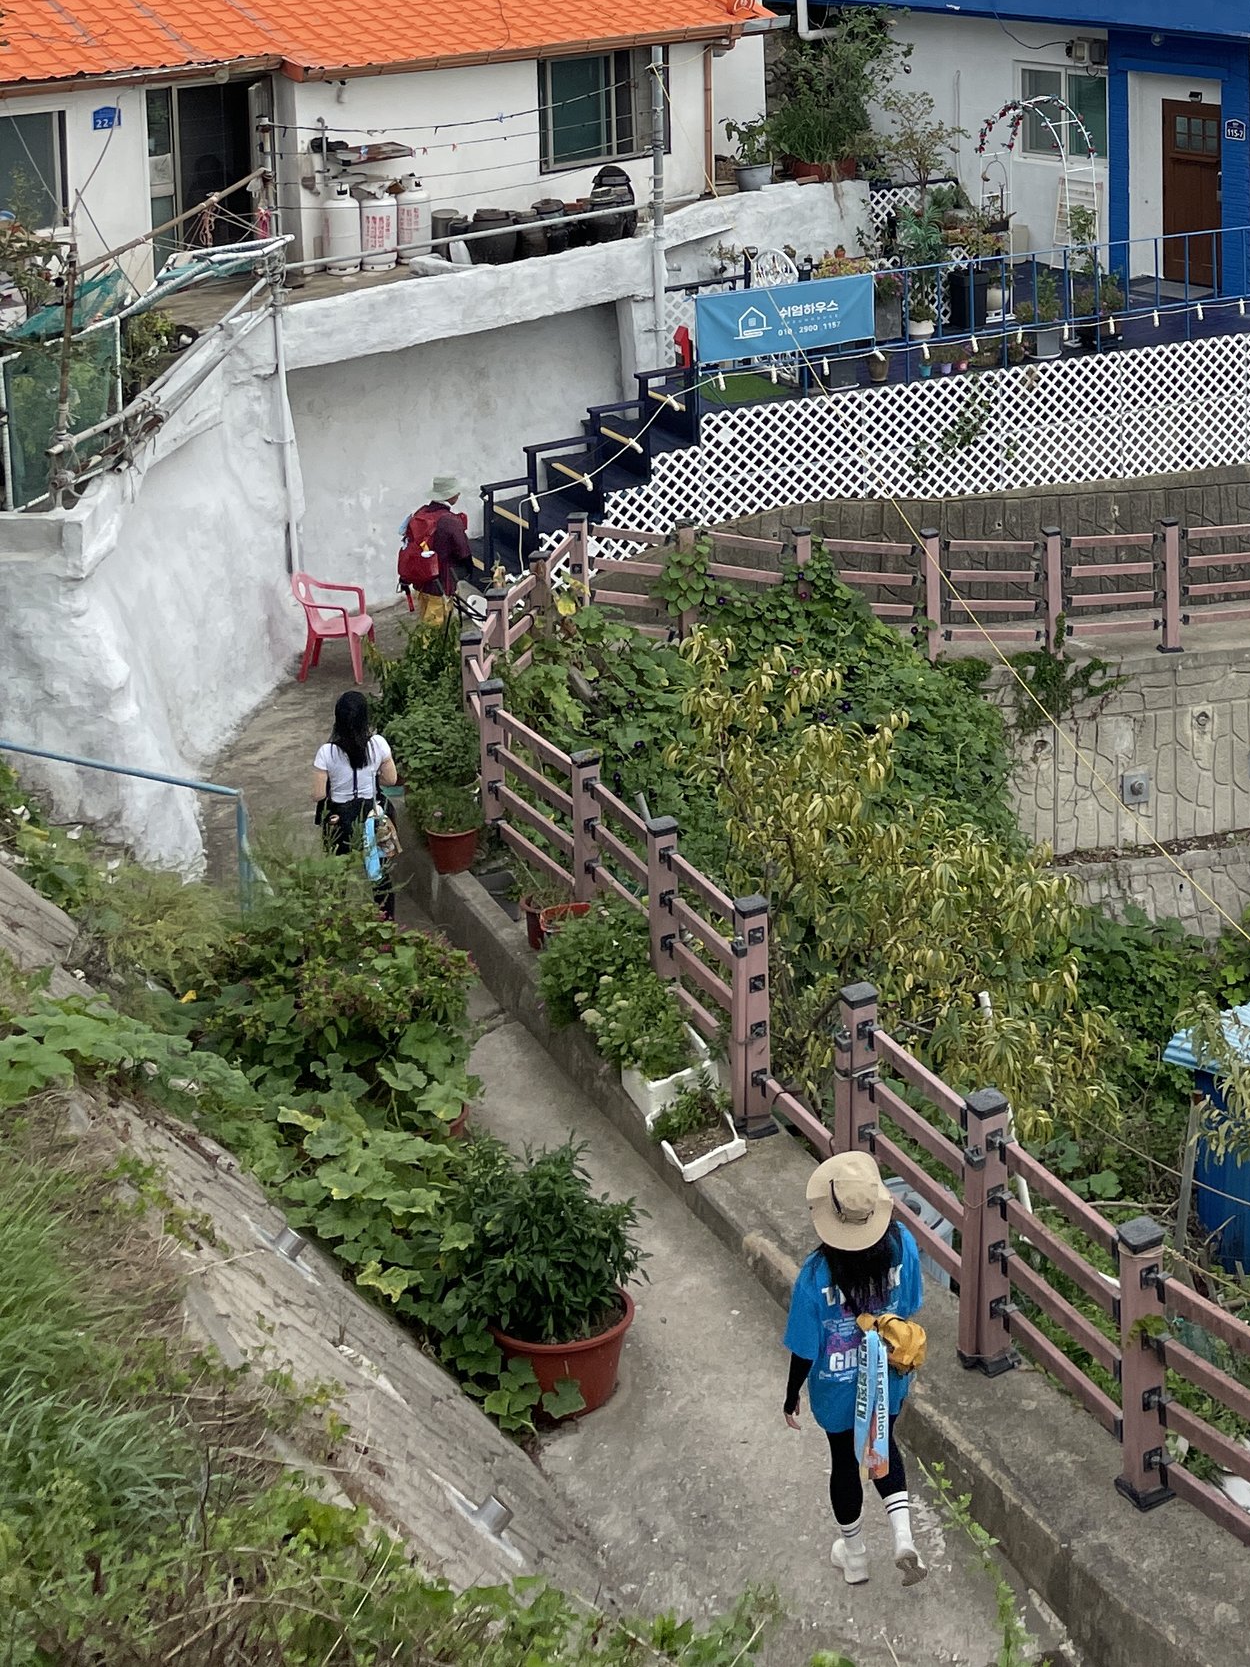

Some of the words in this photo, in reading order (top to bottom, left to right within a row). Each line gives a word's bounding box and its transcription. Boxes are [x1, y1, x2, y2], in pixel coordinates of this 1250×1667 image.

[1227, 129, 1243, 138] 115-7
[779, 300, 839, 319] 쉬엄하우스
[777, 328, 793, 336] 010
[823, 321, 841, 330] 1157
[877, 1372, 885, 1440] Expedition
